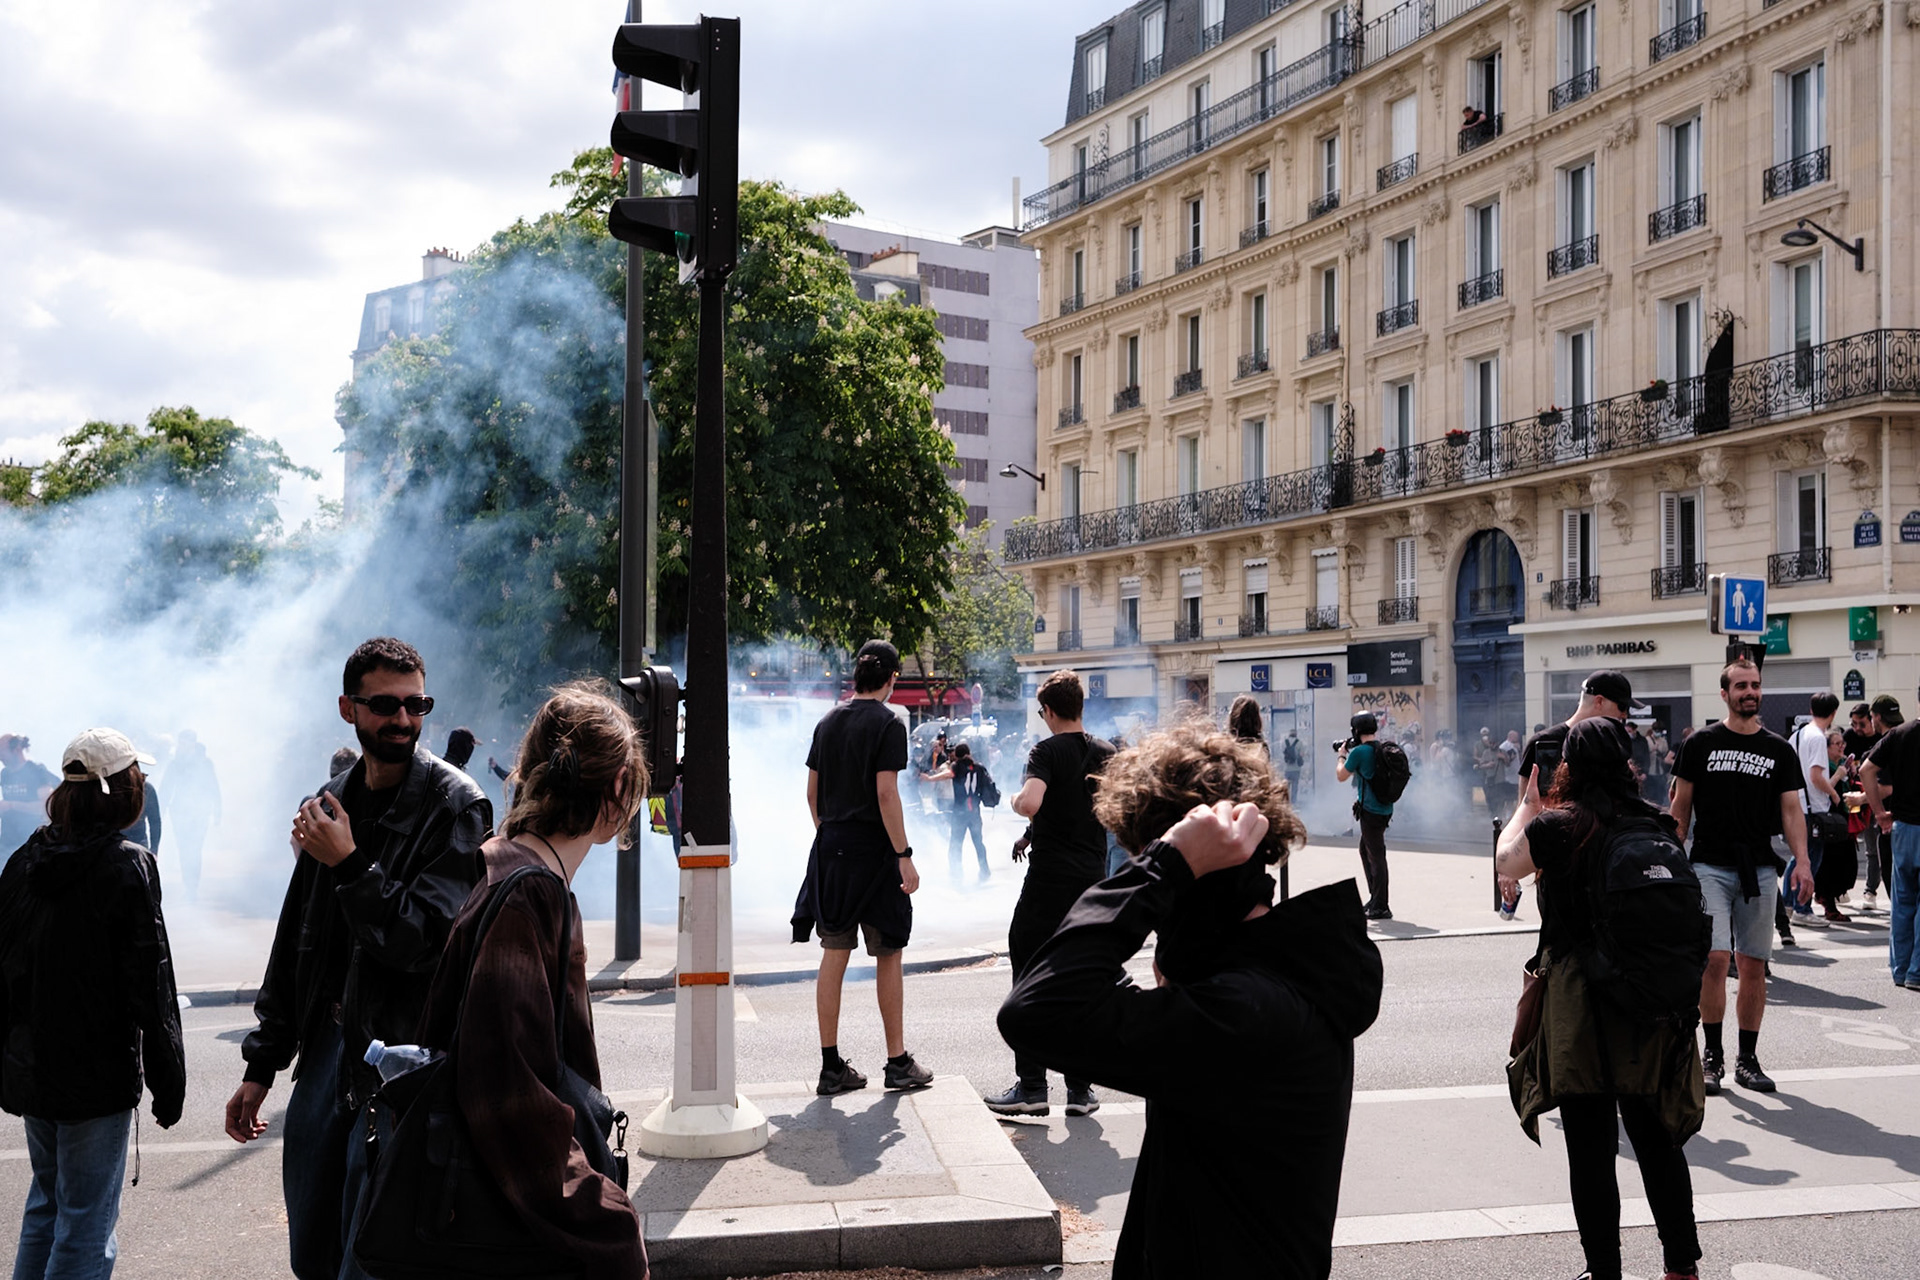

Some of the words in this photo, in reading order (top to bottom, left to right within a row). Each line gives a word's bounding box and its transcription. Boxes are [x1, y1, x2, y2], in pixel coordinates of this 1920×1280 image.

[1566, 645, 1594, 658] BNP
[1596, 640, 1655, 655] PARIBAS
[1390, 651, 1406, 659] Service
[1252, 670, 1267, 680] LCL
[1309, 669, 1329, 678] LCL
[1707, 750, 1775, 770] ANTIFASCISM
[1707, 761, 1737, 772] CAME
